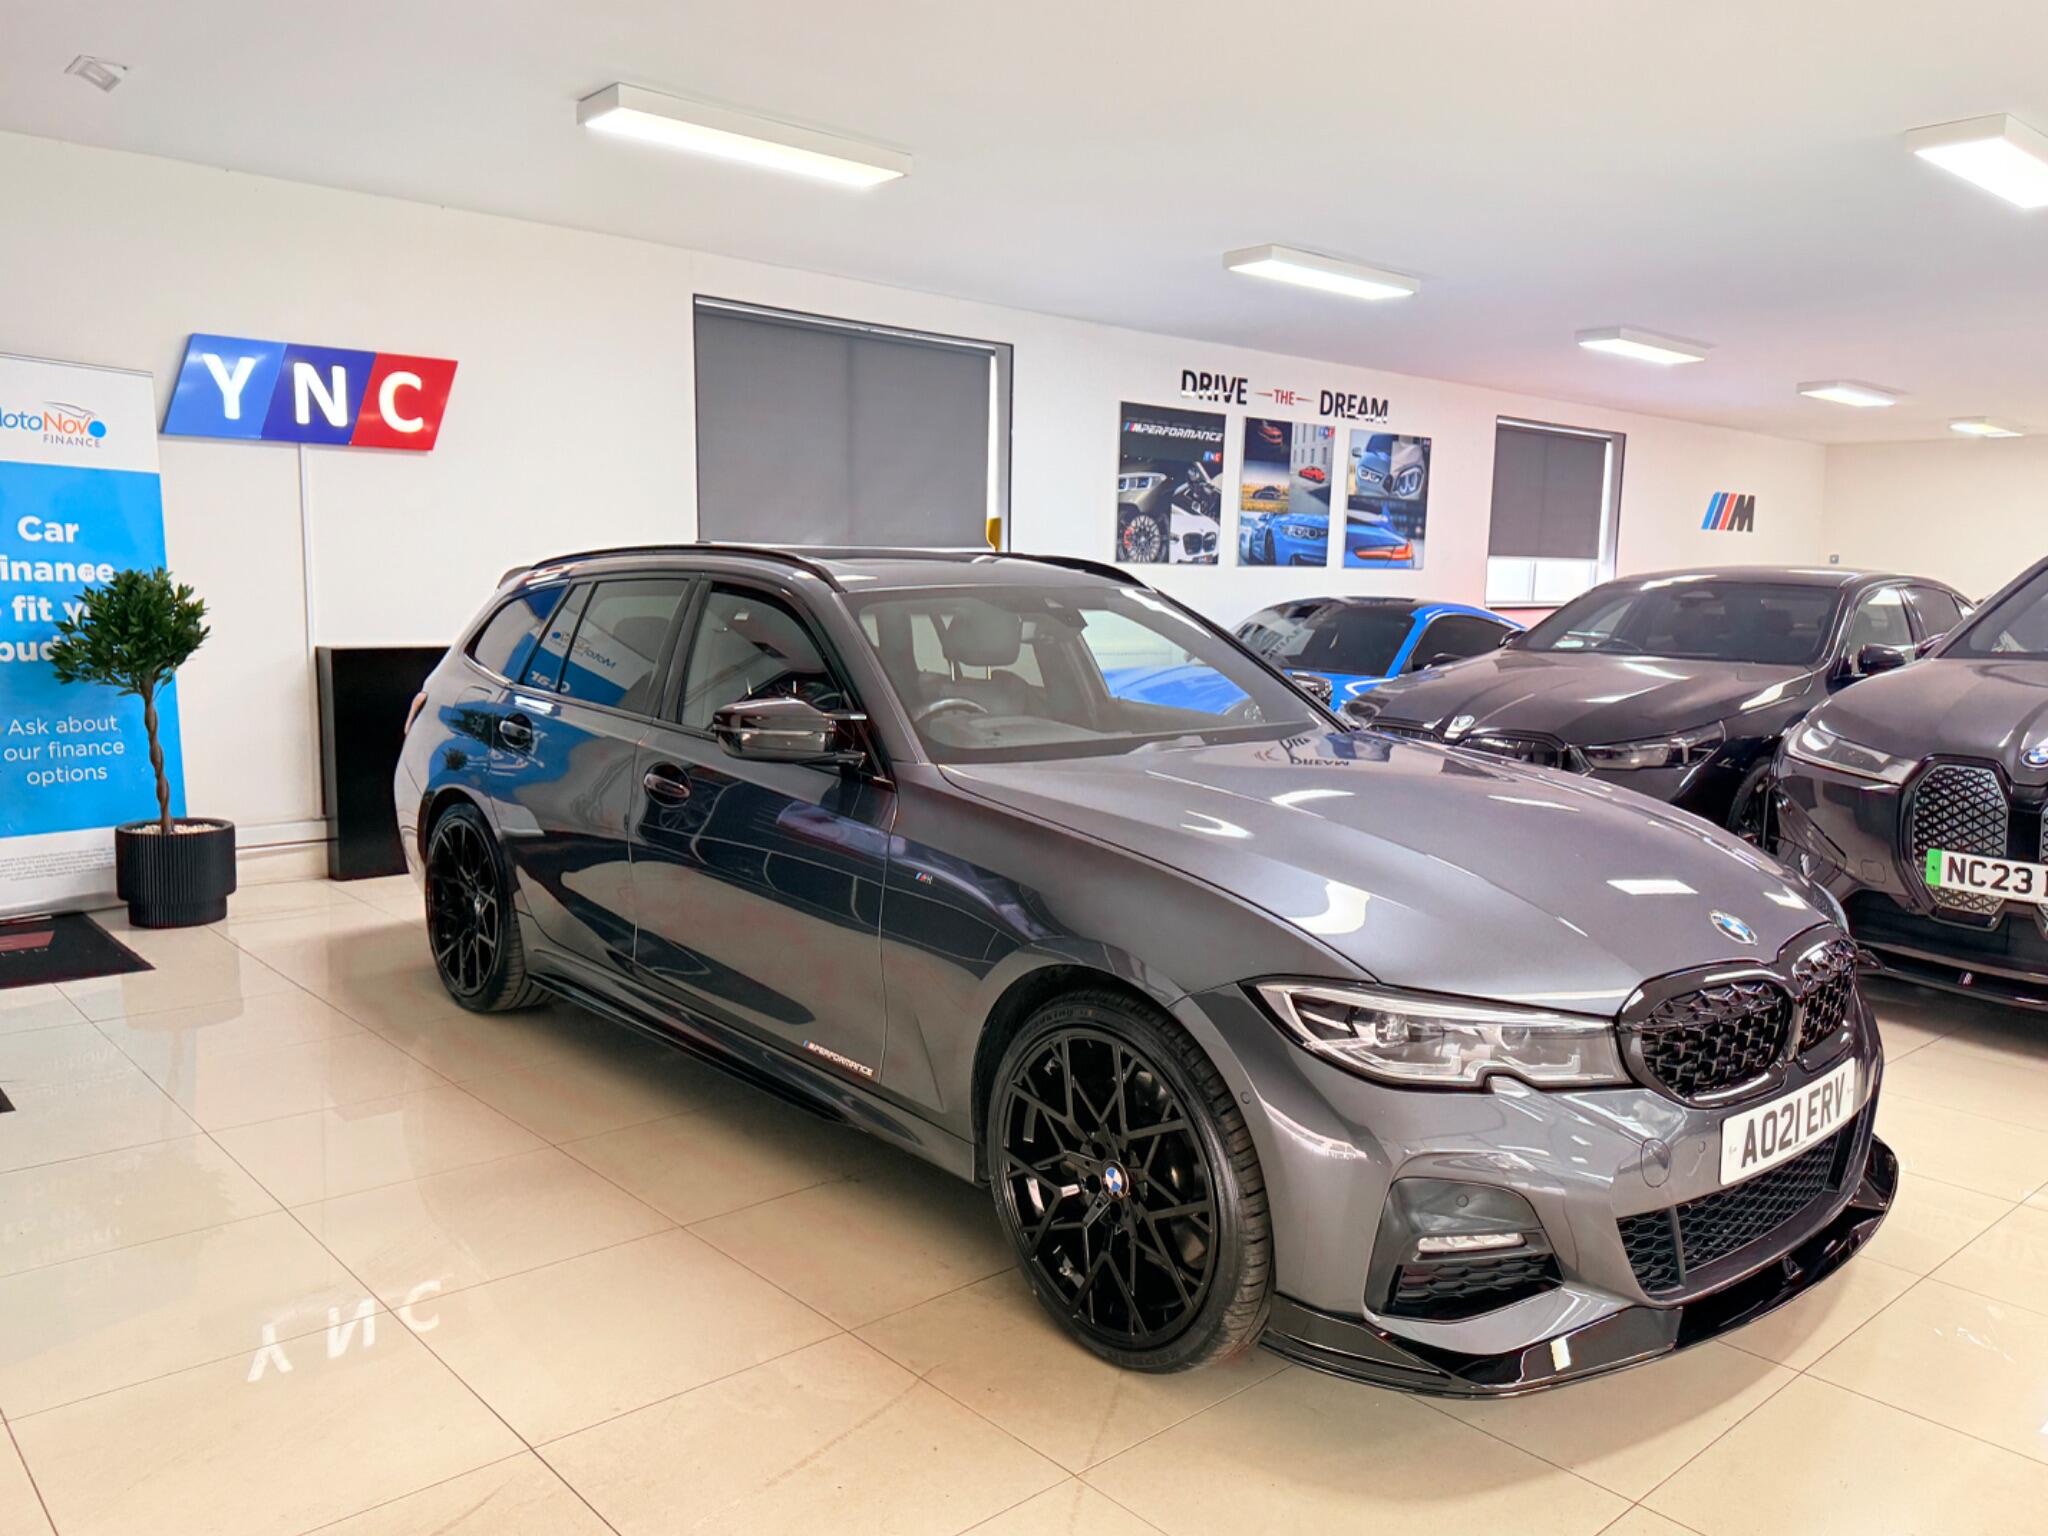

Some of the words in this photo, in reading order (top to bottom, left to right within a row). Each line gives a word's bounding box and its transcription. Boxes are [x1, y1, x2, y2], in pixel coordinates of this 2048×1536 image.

[202, 352, 424, 434] YNC
[1181, 369, 1248, 405] DRIVE
[1273, 388, 1295, 405] THE
[1319, 390, 1389, 424] DREAM
[43, 434, 101, 448] FINANCE
[17, 514, 79, 543] Car
[0, 554, 115, 583] inance
[11, 595, 53, 622] fit
[8, 717, 50, 736] Ask
[55, 715, 119, 734] about
[3, 745, 41, 762] our
[48, 741, 124, 759] finance
[26, 765, 108, 787] options
[1947, 856, 2033, 894] NC23
[1741, 1098, 1801, 1168] AO21
[1806, 1072, 1845, 1137] ERV
